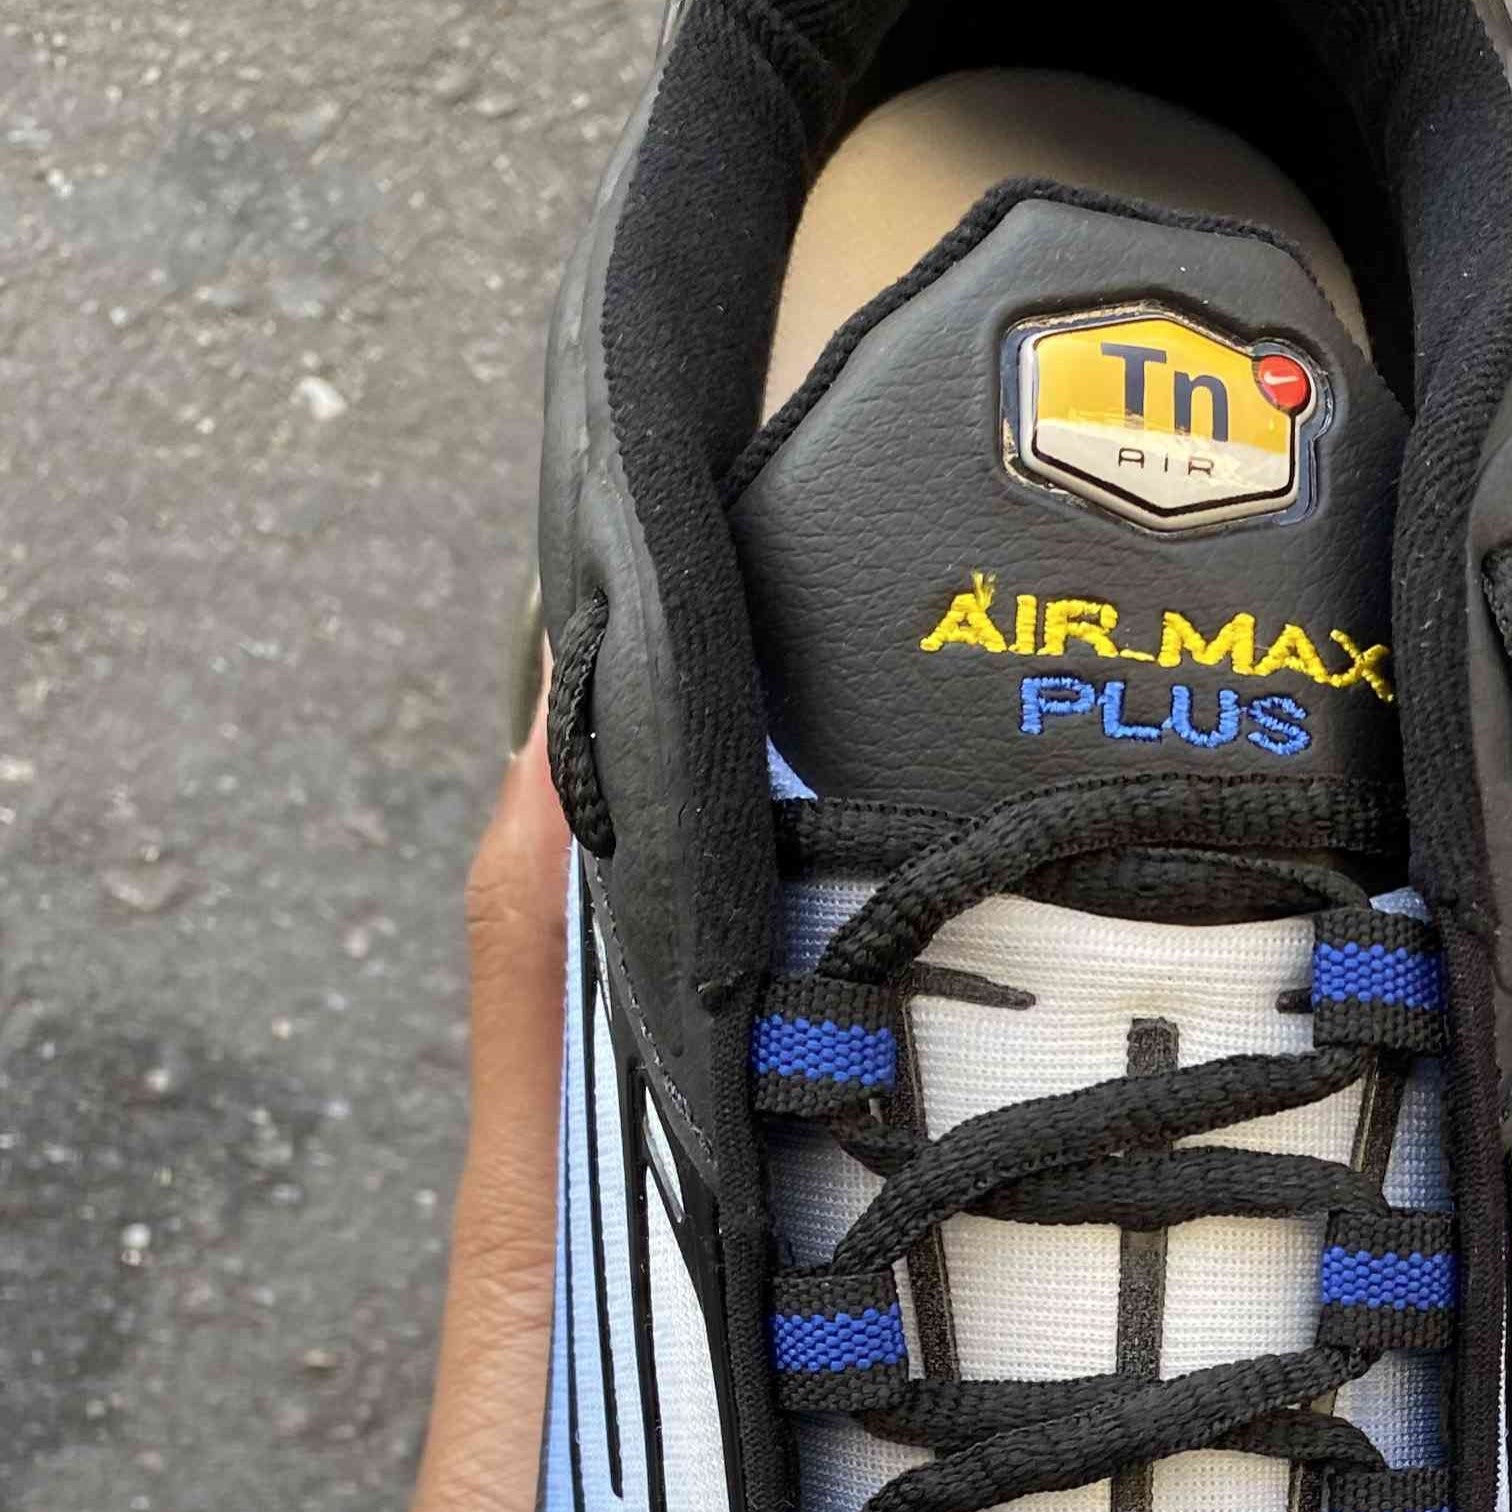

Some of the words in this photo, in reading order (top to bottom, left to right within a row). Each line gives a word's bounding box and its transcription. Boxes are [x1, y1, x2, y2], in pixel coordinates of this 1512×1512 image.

[1100, 343, 1230, 442] Tn
[1118, 447, 1215, 476] AIR
[920, 584, 1118, 657] AIR
[1158, 611, 1393, 703] MAX
[1019, 675, 1311, 755] PLUS
